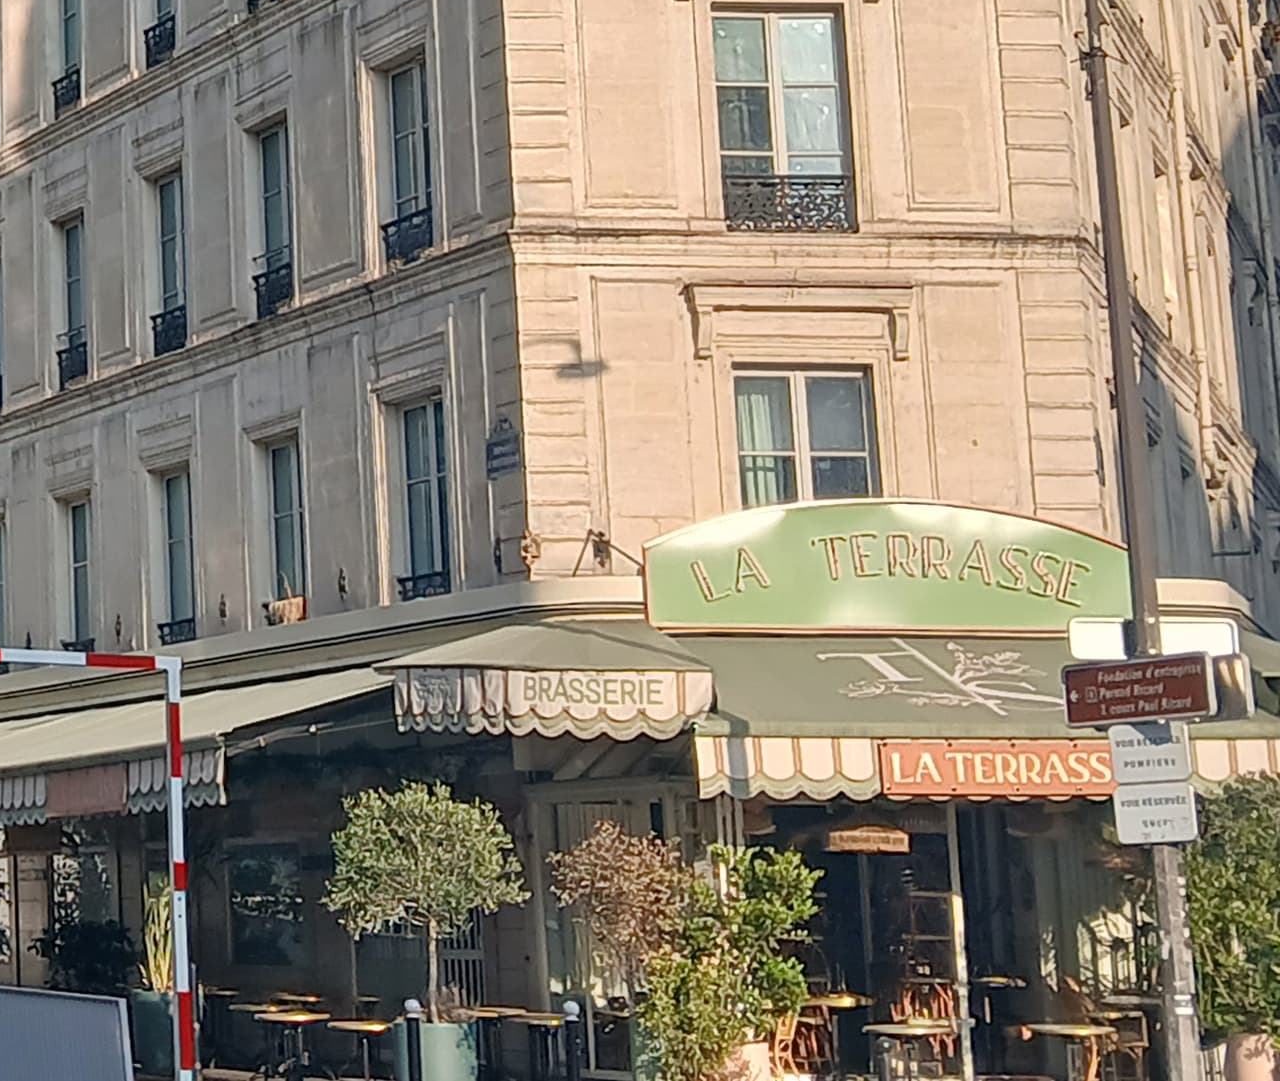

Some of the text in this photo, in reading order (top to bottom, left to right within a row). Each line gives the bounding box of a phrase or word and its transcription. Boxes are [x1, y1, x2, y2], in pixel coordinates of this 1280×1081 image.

[690, 533, 1091, 607] LA TERRASSE
[523, 675, 664, 706] BRASSERIE
[890, 751, 1113, 785] LA TERRASS
